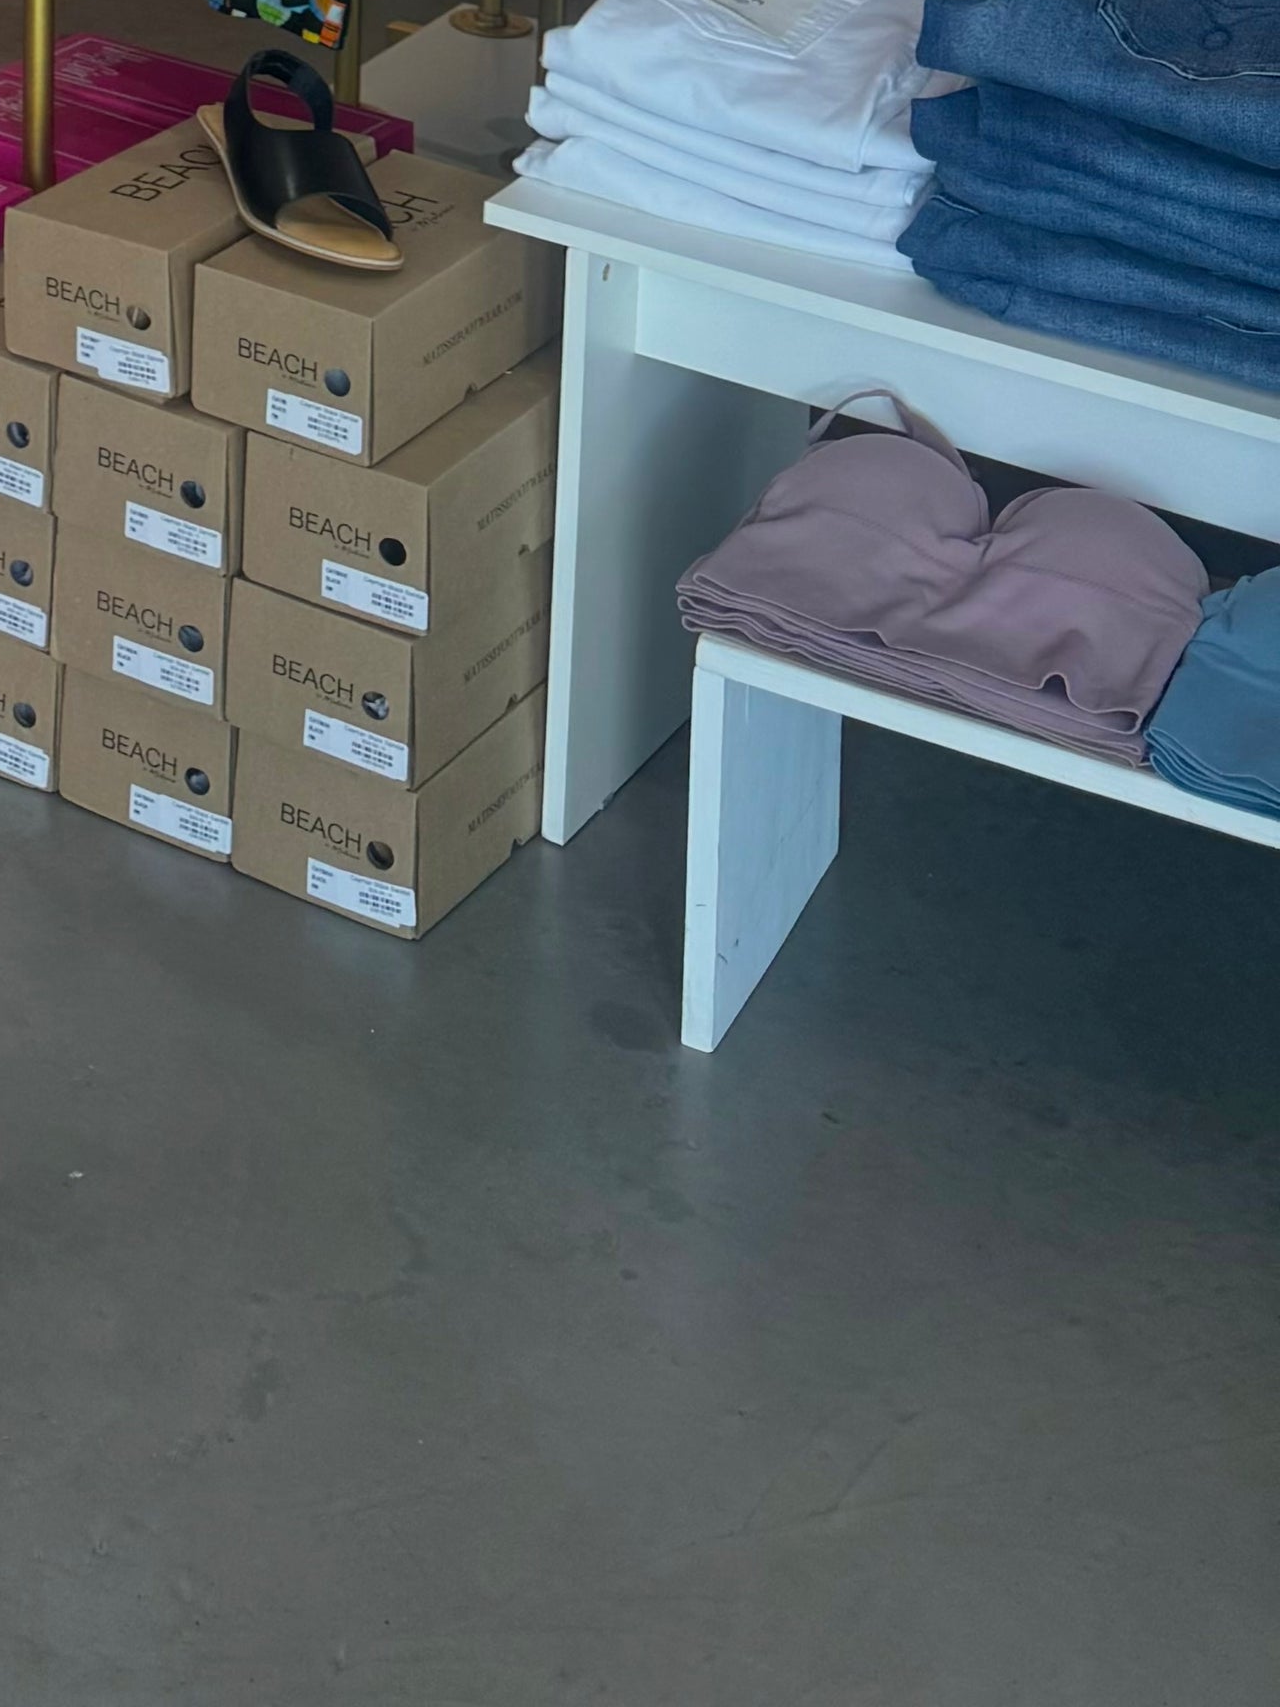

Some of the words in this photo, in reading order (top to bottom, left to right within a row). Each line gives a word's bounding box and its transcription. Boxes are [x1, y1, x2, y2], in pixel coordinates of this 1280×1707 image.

[110, 145, 222, 202] BEAC
[46, 276, 120, 315] BEACH
[238, 337, 318, 382] BEACH
[98, 446, 173, 492] BEACH
[289, 506, 371, 551] BEACH
[97, 590, 173, 636] BEACH
[273, 654, 354, 703] BEACH
[102, 727, 177, 776] BEACH
[280, 802, 361, 853] BEACH
